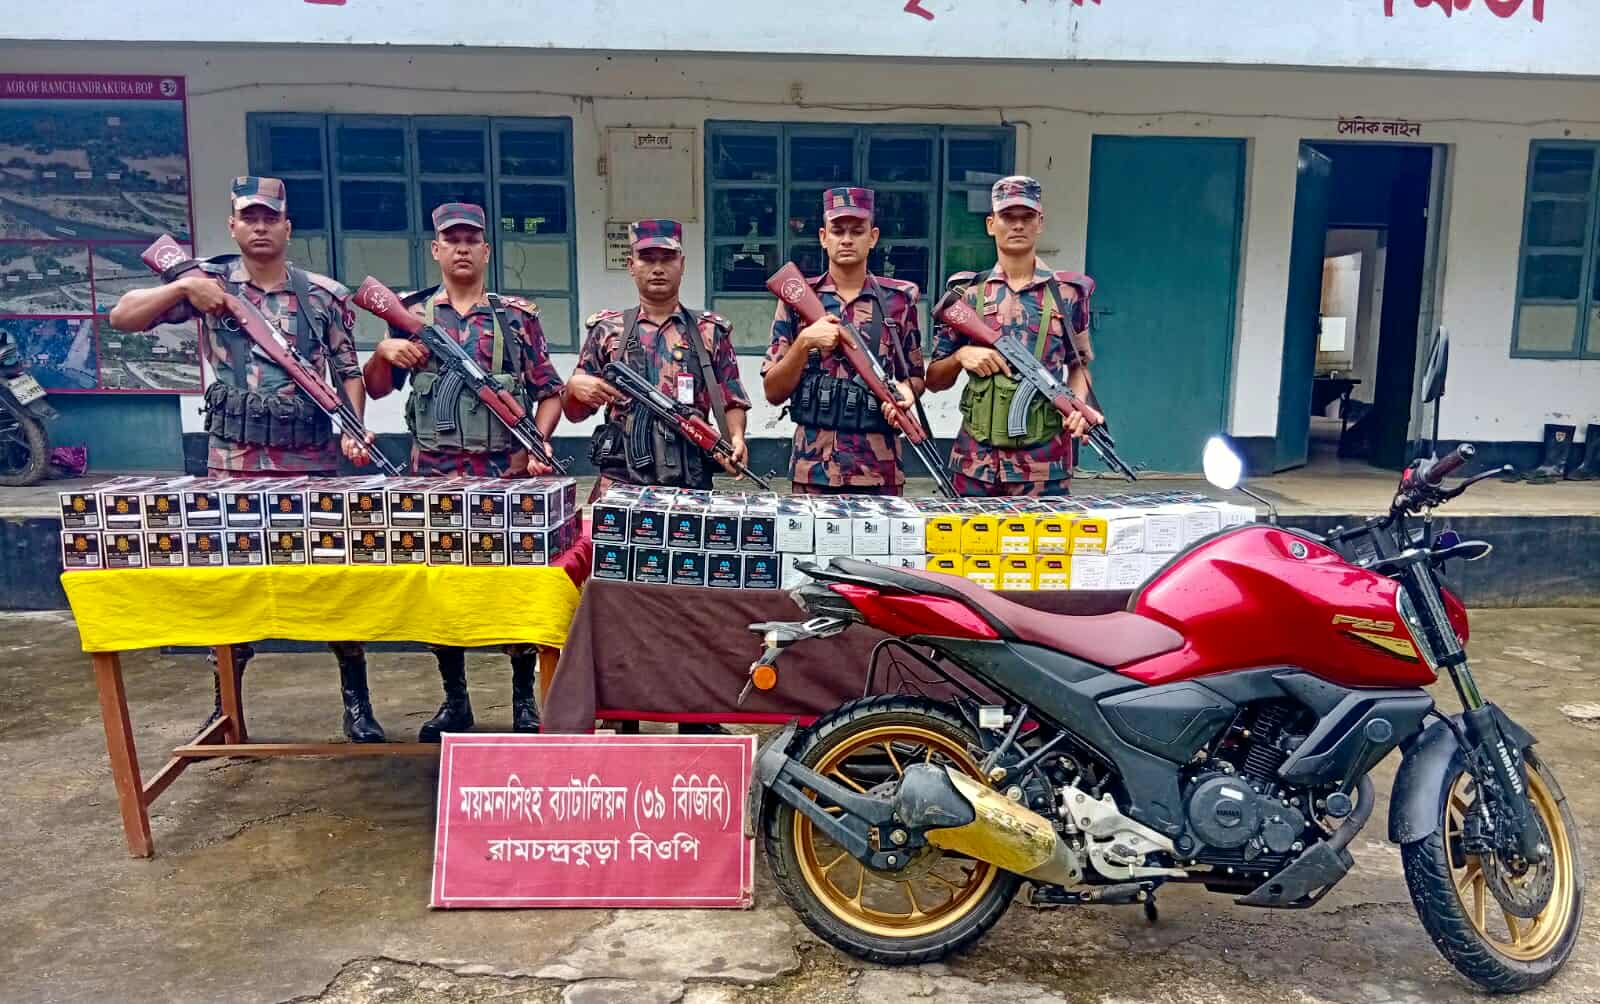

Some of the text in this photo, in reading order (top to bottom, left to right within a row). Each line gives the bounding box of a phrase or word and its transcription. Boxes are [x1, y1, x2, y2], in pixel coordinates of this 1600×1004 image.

[6, 79, 153, 95] AOR OF RAMCHANDRAKURA BOP
[1337, 116, 1422, 136] সৈনিক লাইন
[1496, 739, 1522, 795] YAMAHA
[459, 773, 731, 831] ময়মনসিংহ ব্যাটালিয়ন (৩৯ বিজিবি)
[487, 832, 701, 868] রামচন্দ্রকুড়া বিওপি
